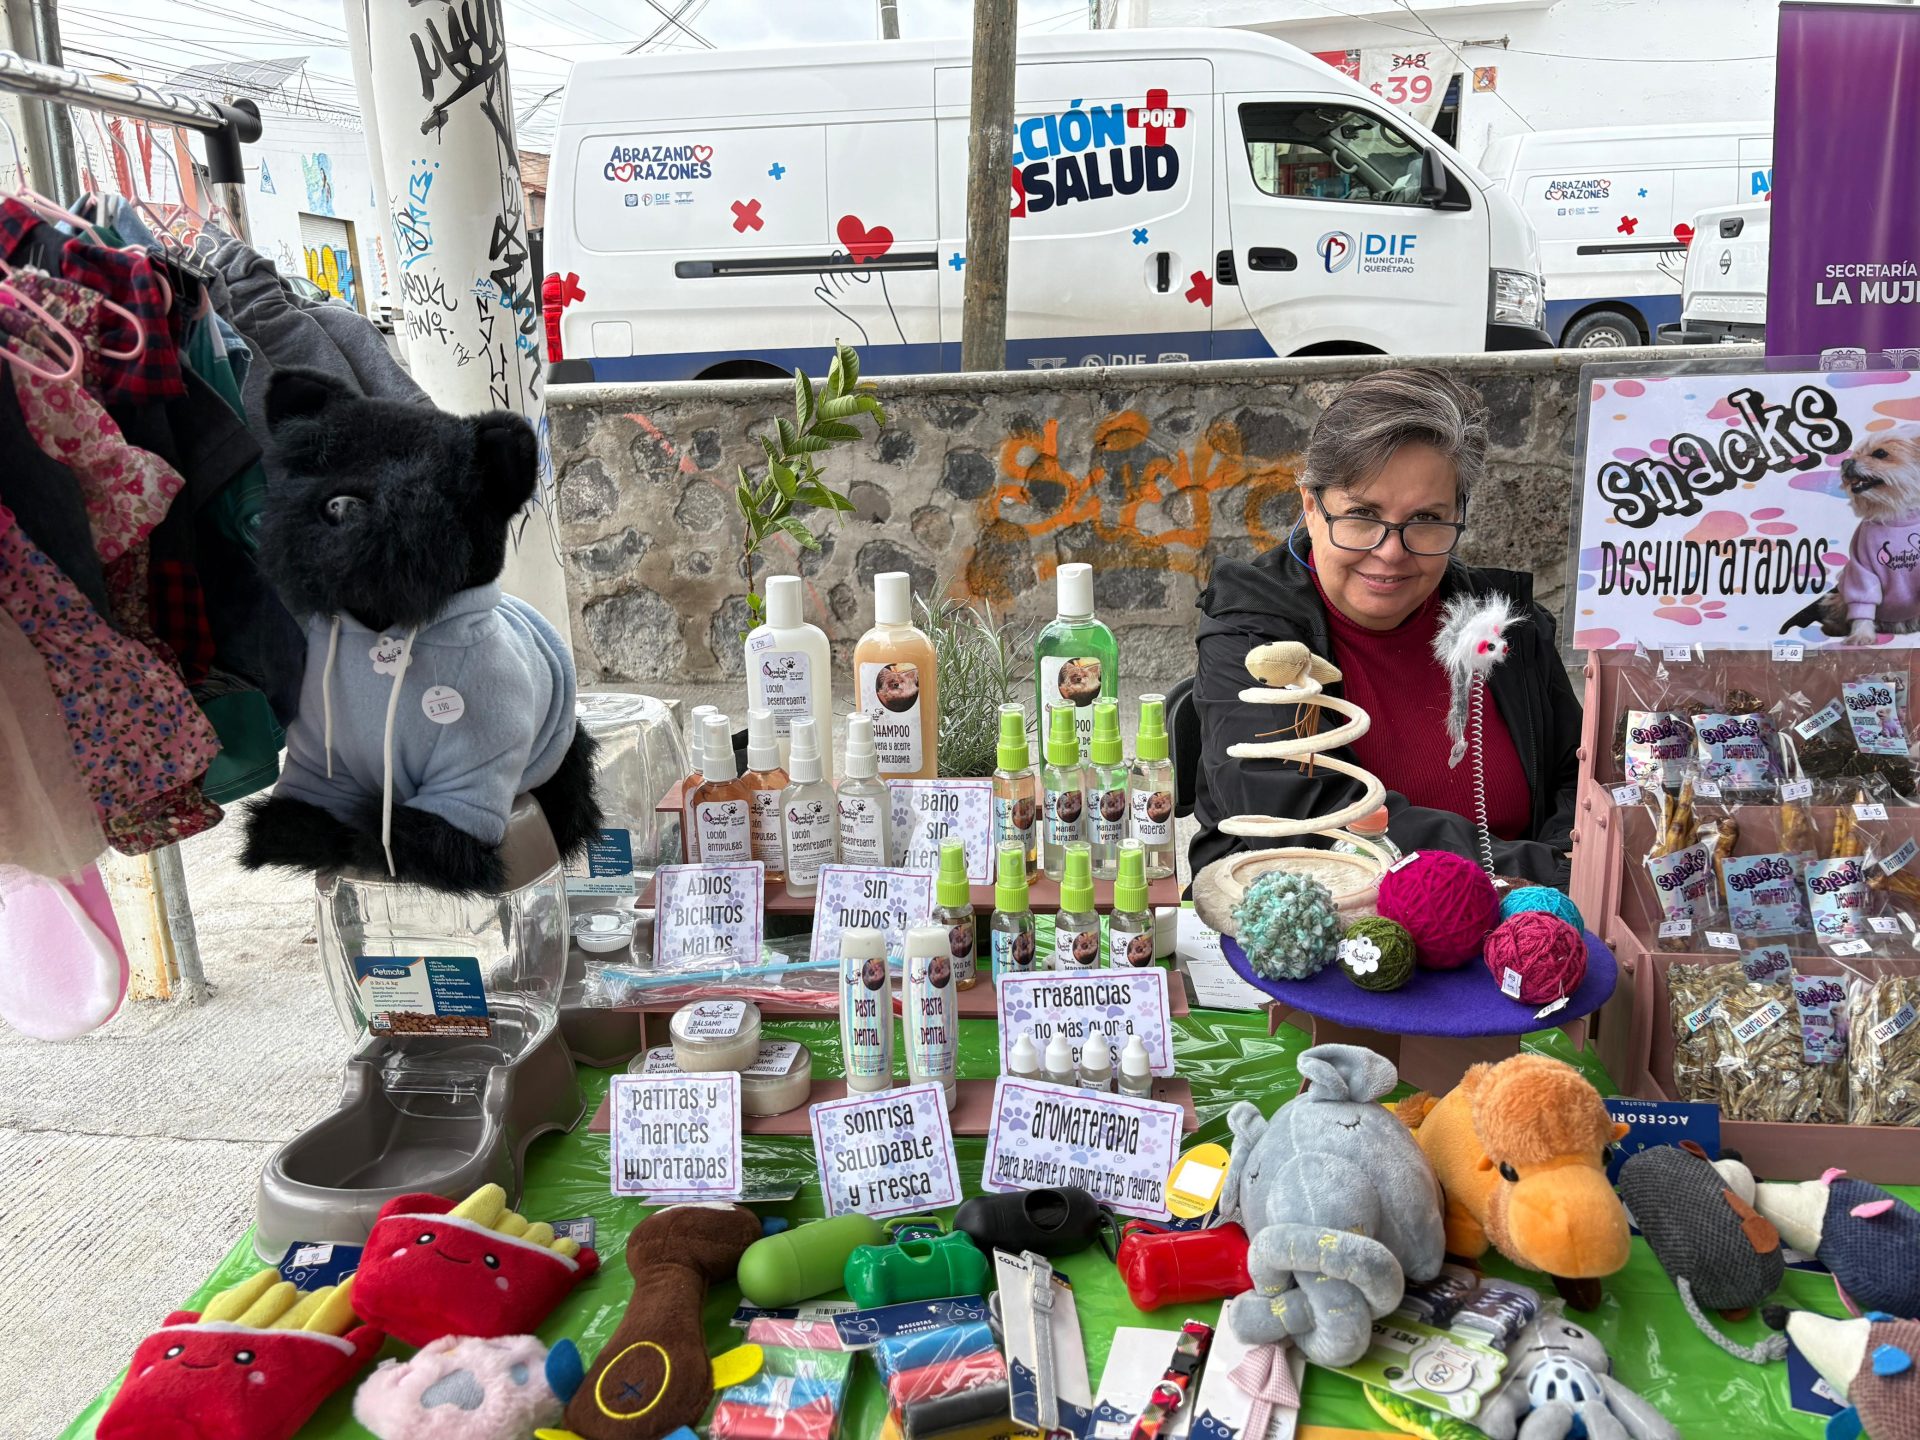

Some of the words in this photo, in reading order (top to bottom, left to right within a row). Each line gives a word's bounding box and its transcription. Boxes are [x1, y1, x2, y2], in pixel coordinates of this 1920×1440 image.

[1370, 75, 1432, 104] $39
[1137, 108, 1176, 128] POR
[1021, 143, 1180, 213] SALUD
[1365, 234, 1417, 255] DIF
[1363, 264, 1415, 273] QUERÉTARO
[1364, 257, 1415, 265] MUNICIPAL
[1825, 260, 1919, 278] SECRETARÍA
[1815, 281, 1853, 305] LA
[1860, 280, 1920, 305] MUJ
[1597, 385, 1853, 528] Snacks
[1790, 649, 1798, 657] 60
[919, 789, 959, 812] Baño
[926, 821, 949, 840] sin
[1140, 824, 1166, 835] maderas
[1728, 858, 1793, 892] snacks
[1809, 860, 1866, 894] snack
[863, 878, 888, 900] sin
[674, 904, 744, 927] BICHITOS
[838, 908, 890, 930] nudos
[1678, 923, 1686, 931] 30
[372, 967, 406, 976] Petmate
[920, 996, 943, 1016] pasta
[1032, 984, 1132, 1008] Fragancias
[854, 999, 876, 1018] pasta
[1034, 1022, 1052, 1040] no
[1057, 1017, 1083, 1038] más
[1126, 1019, 1134, 1036] a
[1737, 1004, 1781, 1039] charalitos
[1874, 1008, 1914, 1041] charalitos
[853, 1028, 880, 1047] dental
[920, 1025, 948, 1046] dental
[632, 1086, 699, 1111] patitas
[707, 1086, 717, 1109] y
[843, 1103, 914, 1136] sonrisa
[1031, 1100, 1140, 1155] aromaterapia
[641, 1122, 709, 1145] narices
[835, 1135, 934, 1174] saludable
[624, 1156, 727, 1180] hidratadas
[997, 1154, 1020, 1178] para
[1021, 1158, 1058, 1185] bajarle
[1059, 1165, 1067, 1186] o
[1068, 1166, 1101, 1193] subirle
[1105, 1172, 1125, 1197] tres
[1127, 1176, 1162, 1204] rayitas
[848, 1184, 859, 1208] y
[868, 1172, 932, 1205] fresca
[895, 1323, 940, 1336] ACCESORIOS
[898, 1319, 933, 1330] MASCOTAS
[1391, 1330, 1419, 1345] PET
